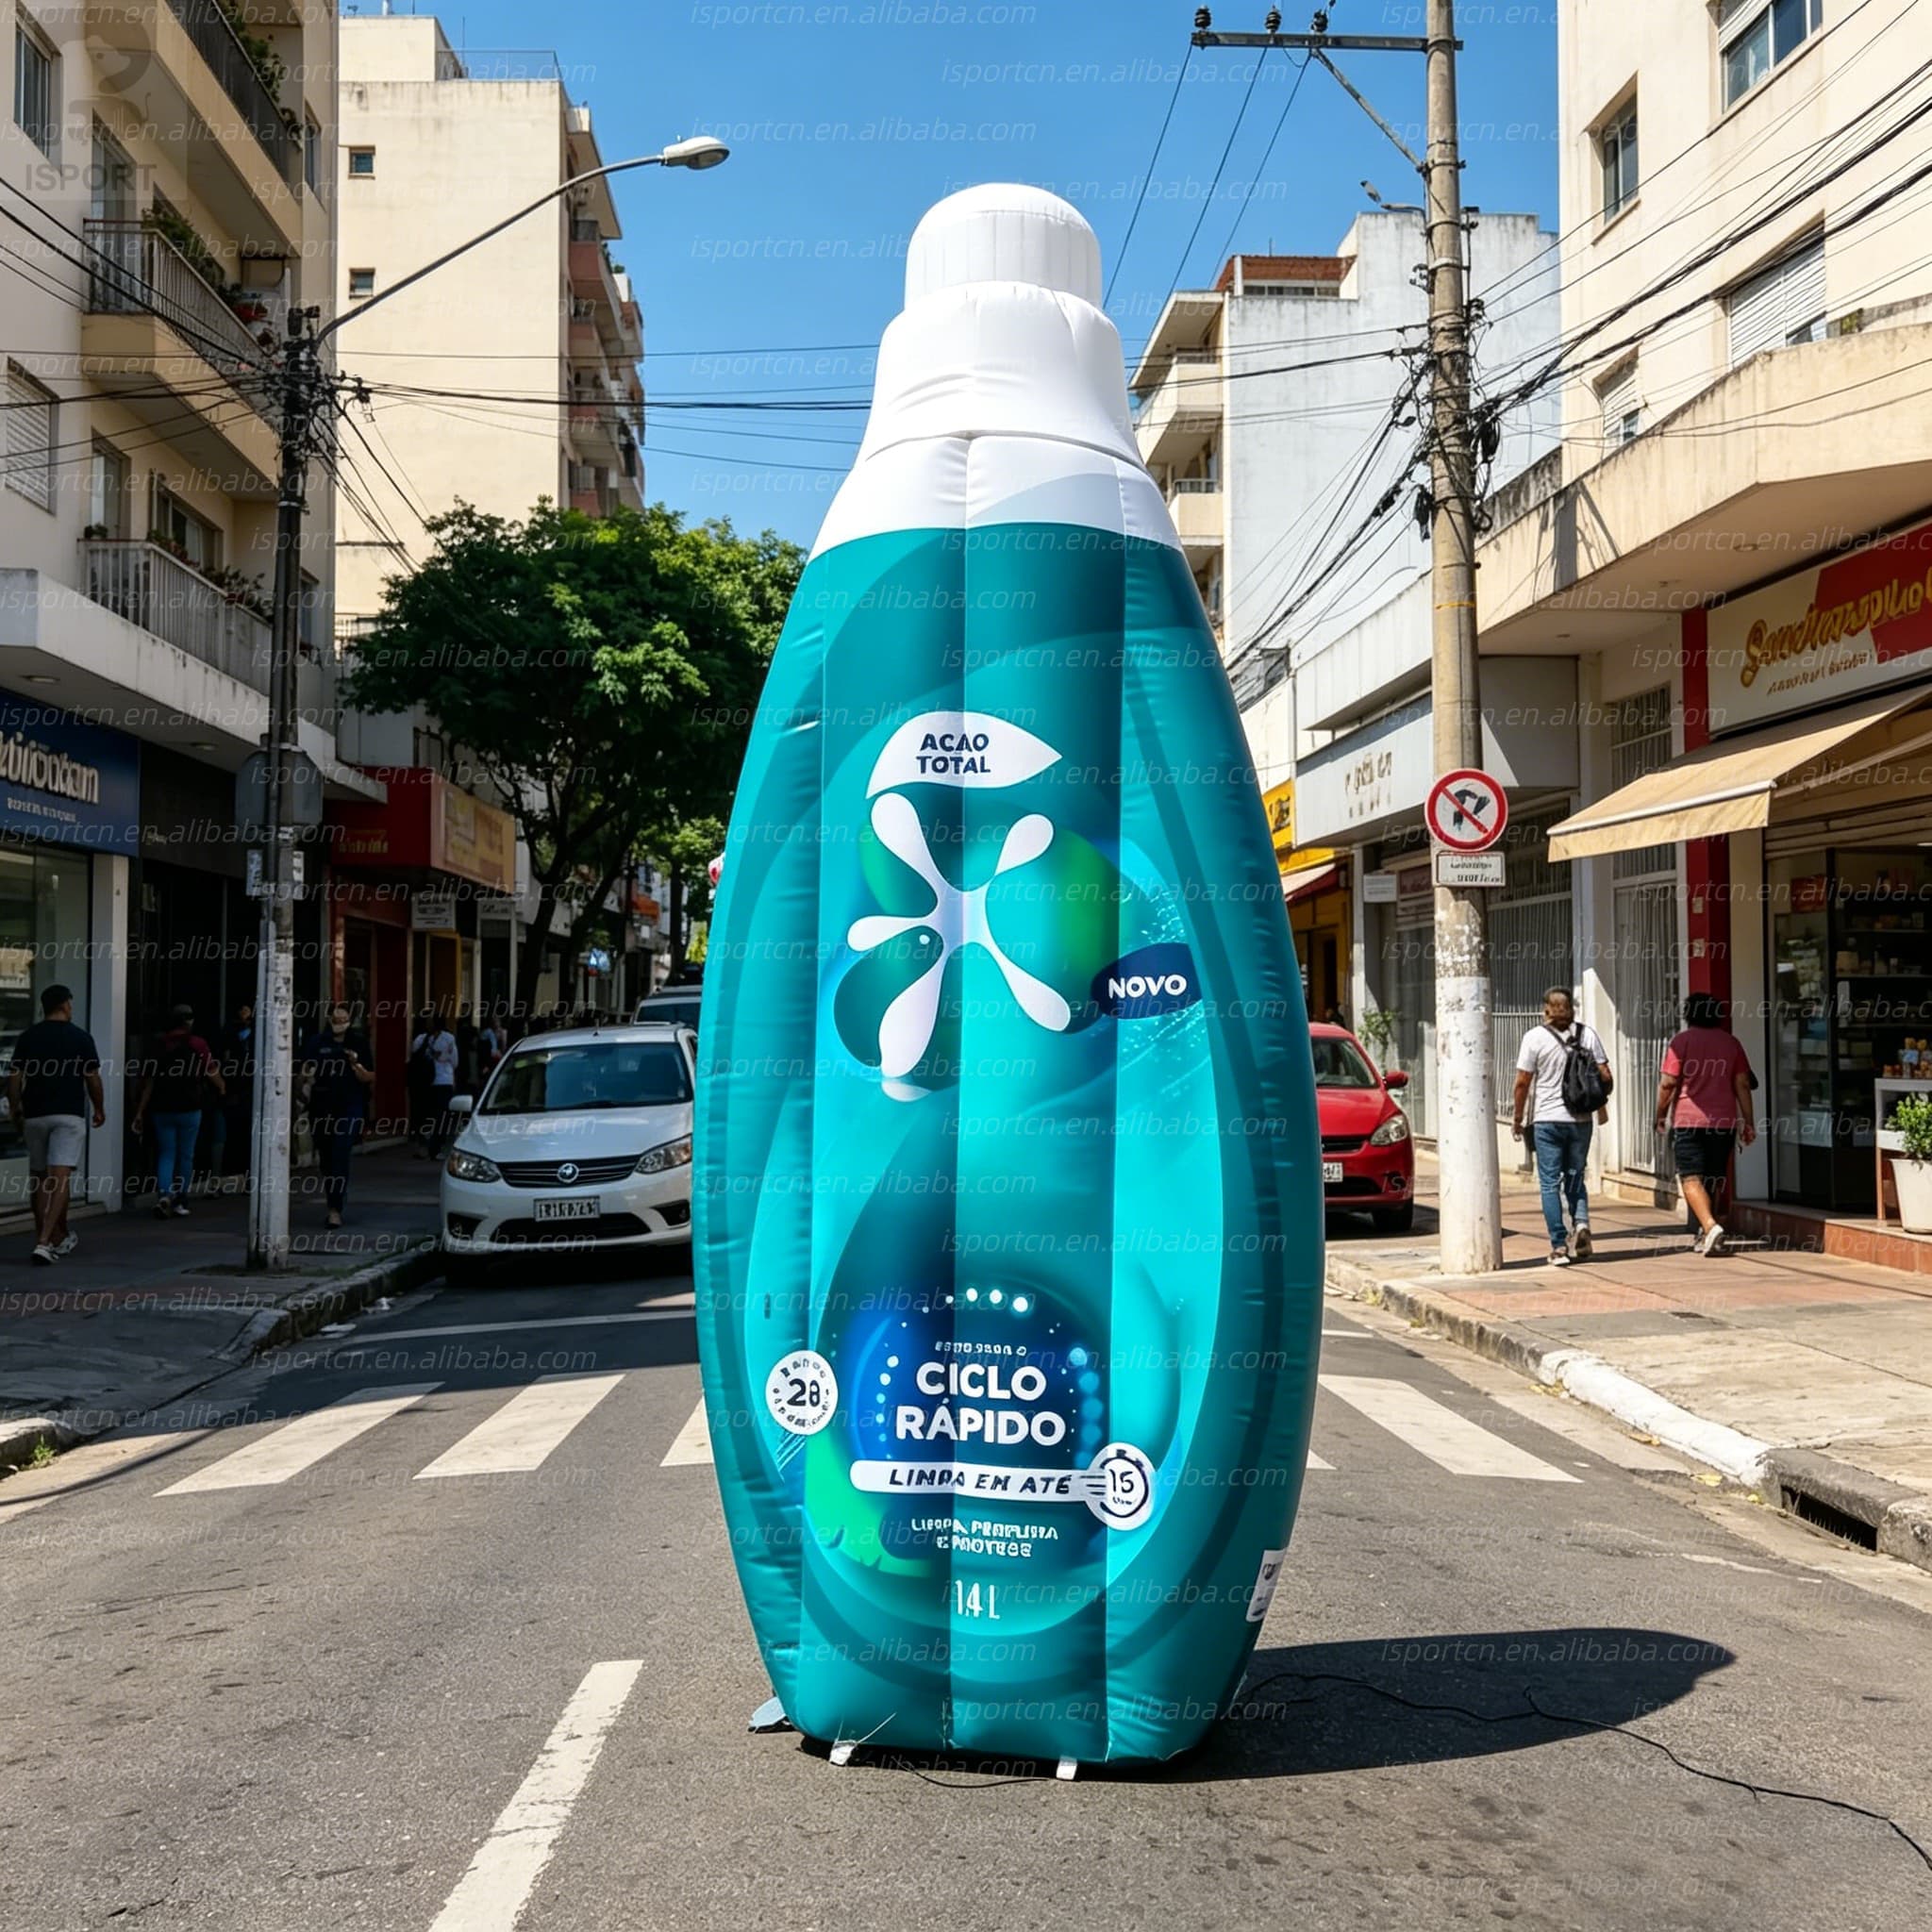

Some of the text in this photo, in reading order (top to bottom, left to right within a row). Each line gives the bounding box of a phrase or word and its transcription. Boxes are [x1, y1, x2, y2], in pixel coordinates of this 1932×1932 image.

[915, 756, 991, 774] TOTAL
[1108, 974, 1187, 999] NOVO
[787, 1378, 821, 1407] 28
[915, 1361, 1047, 1401] CICLO
[895, 1397, 1066, 1446] RÁPIDO
[1109, 1468, 1135, 1493] 15
[989, 1584, 1001, 1620] L
